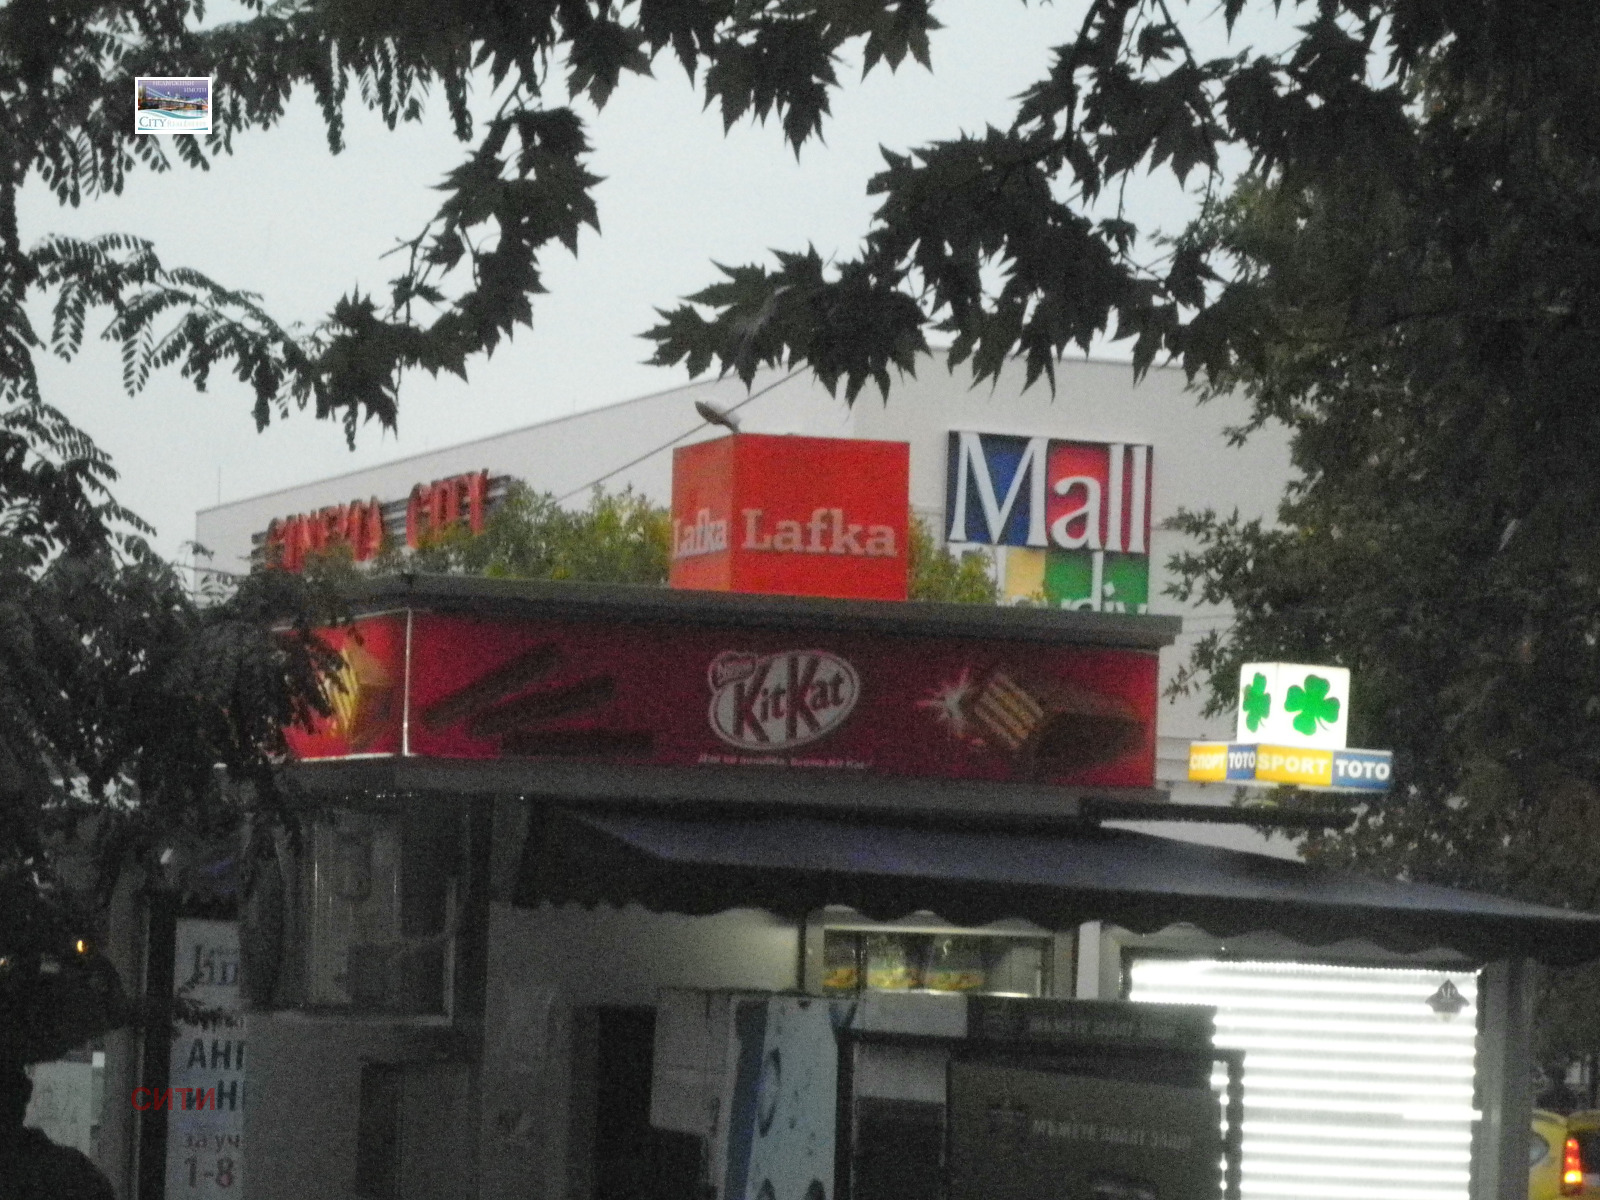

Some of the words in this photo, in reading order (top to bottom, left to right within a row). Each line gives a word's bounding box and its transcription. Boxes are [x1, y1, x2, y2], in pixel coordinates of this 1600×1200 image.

[948, 430, 1148, 554] Mall
[672, 507, 728, 559] Lafka
[741, 507, 898, 558] Lafka
[1257, 754, 1330, 775] SPORT
[1335, 759, 1390, 781] TOTO
